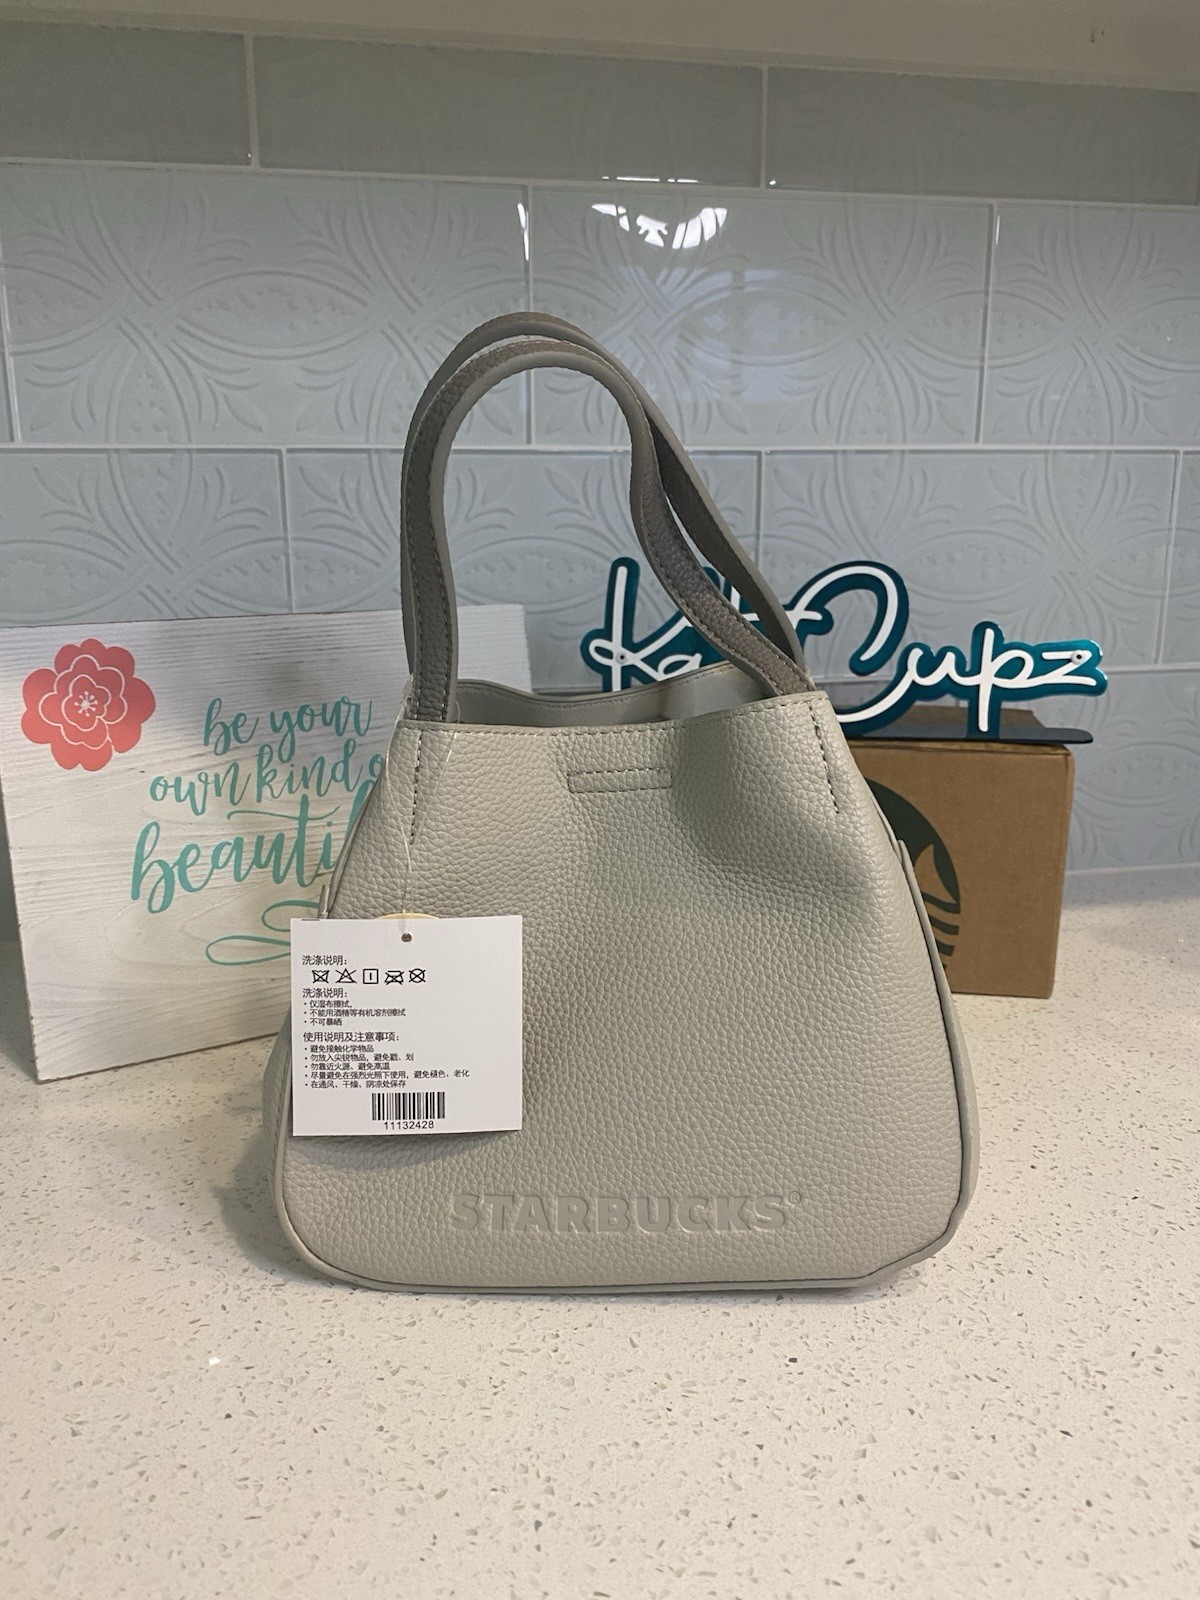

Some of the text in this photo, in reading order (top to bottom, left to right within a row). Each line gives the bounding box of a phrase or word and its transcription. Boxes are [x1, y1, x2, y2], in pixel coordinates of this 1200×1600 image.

[203, 694, 373, 764] be your
[149, 756, 252, 816] own
[255, 738, 365, 801] kind
[384, 1120, 435, 1130] 11132428
